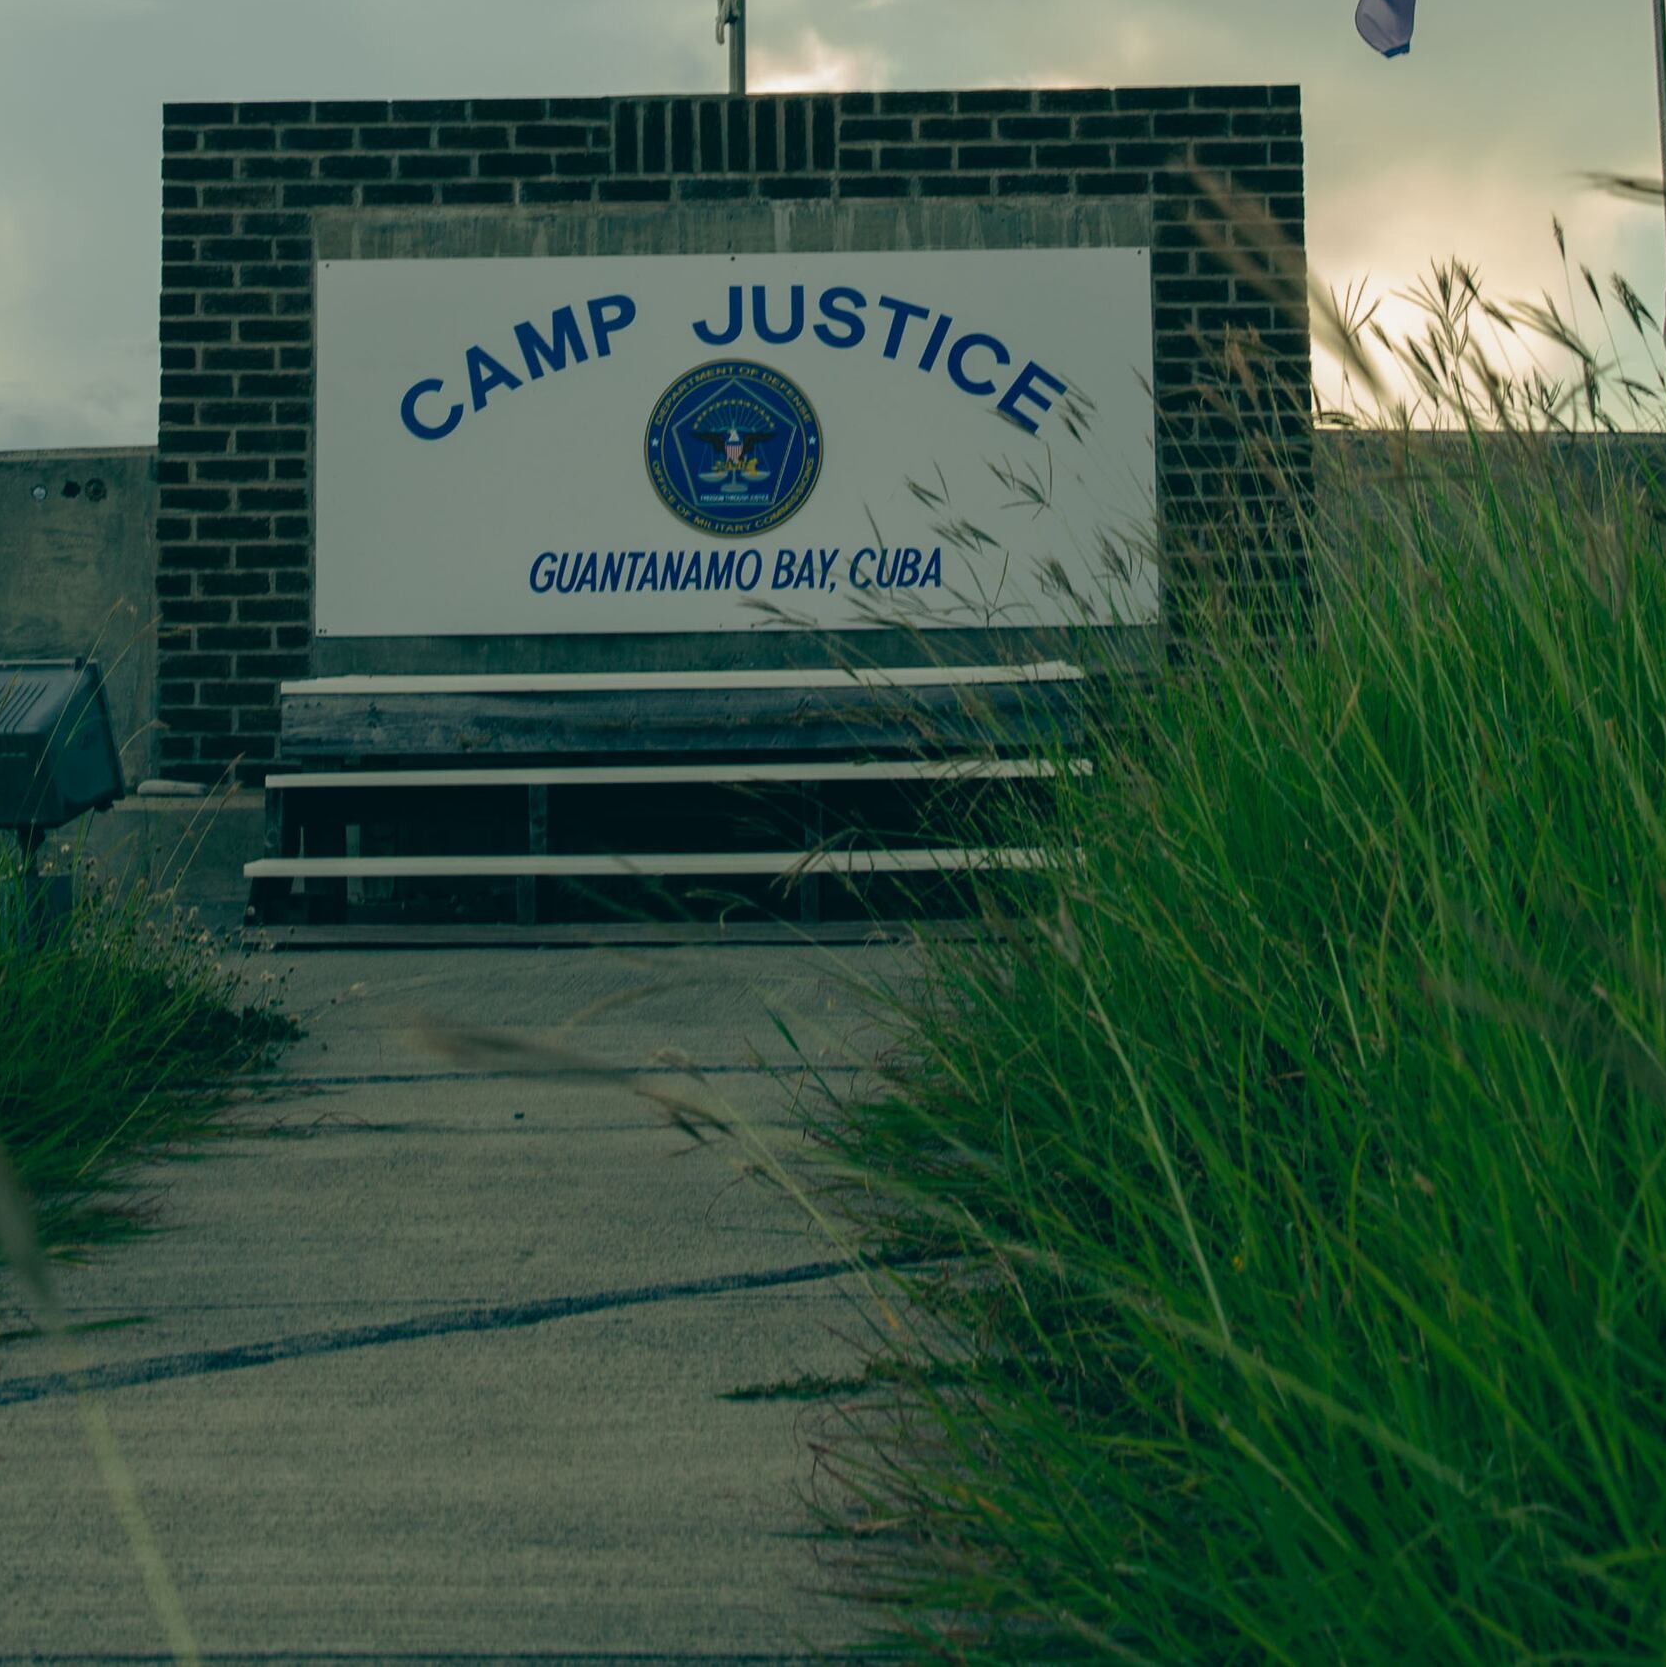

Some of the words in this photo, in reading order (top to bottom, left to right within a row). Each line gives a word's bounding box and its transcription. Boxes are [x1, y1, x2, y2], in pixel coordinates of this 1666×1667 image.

[400, 294, 637, 441] CAMP
[692, 285, 1068, 437] JUSTICE
[654, 366, 733, 425] DEPARTMENT
[739, 366, 758, 376] OF
[762, 369, 812, 423] DEFENSE
[694, 516, 751, 532] MILITARY
[529, 550, 763, 594] GUANTANAMO
[771, 548, 839, 594] BAY,
[849, 547, 942, 591] CUBA
